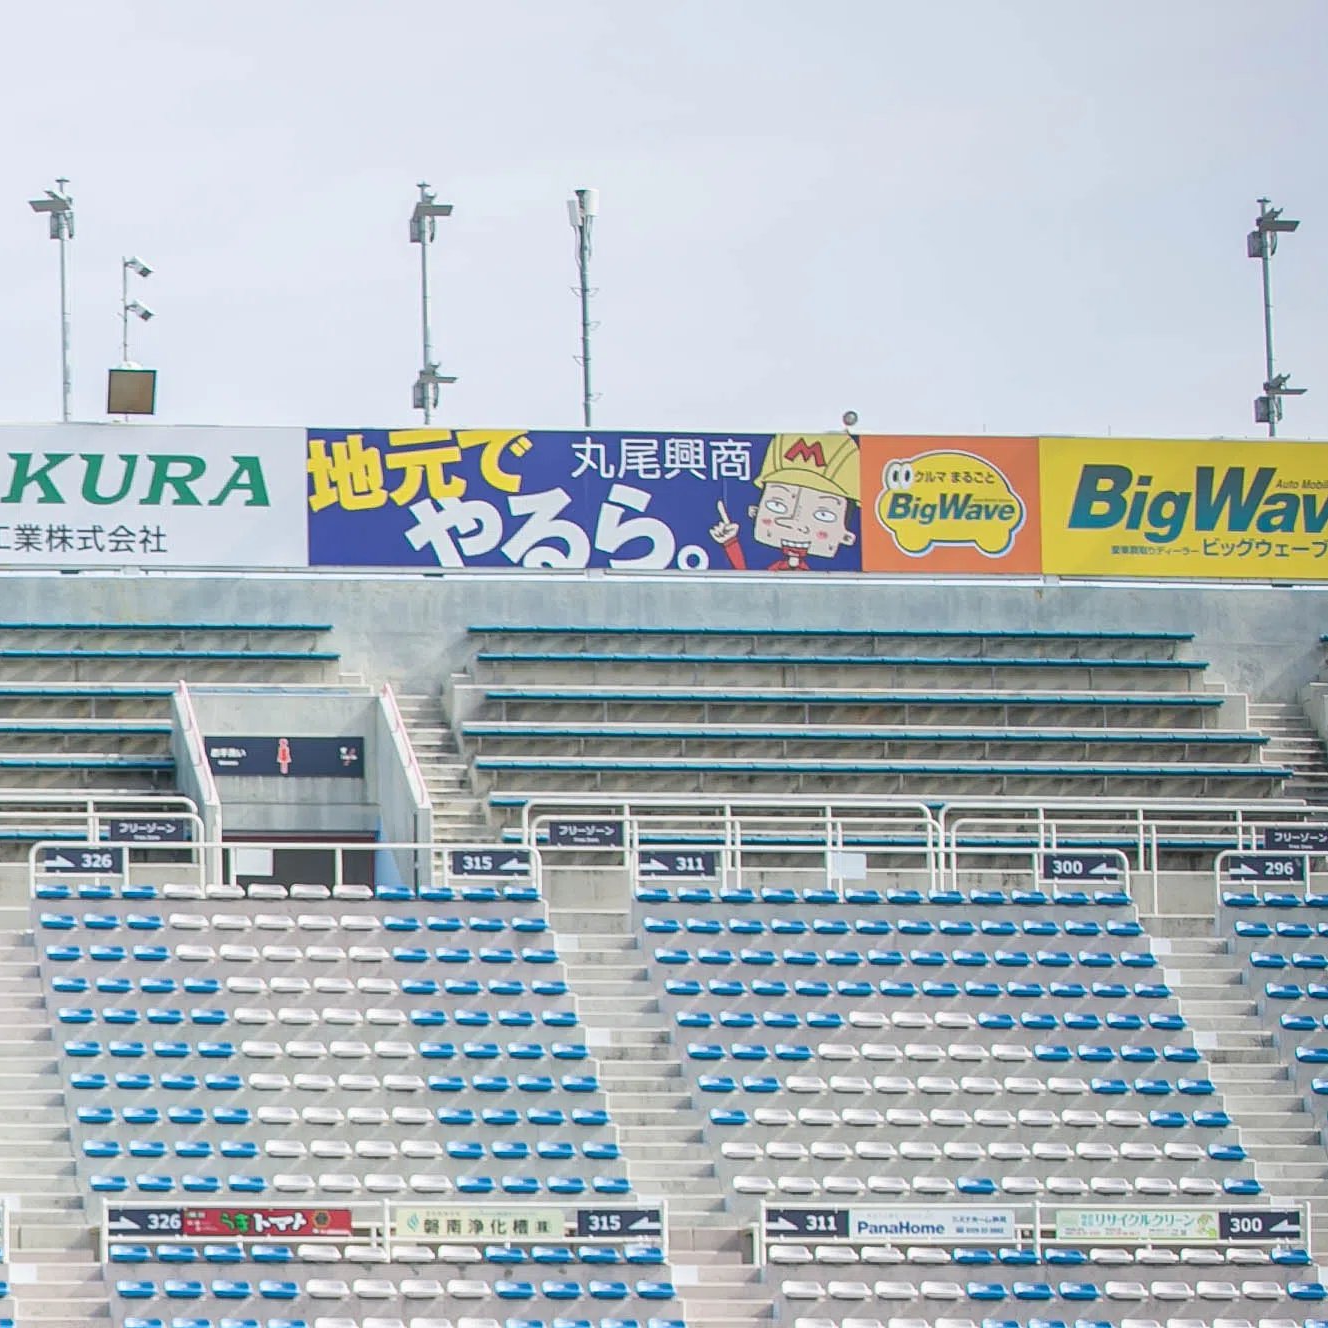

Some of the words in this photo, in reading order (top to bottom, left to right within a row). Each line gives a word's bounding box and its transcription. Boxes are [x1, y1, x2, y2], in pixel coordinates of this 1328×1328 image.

[572, 437, 752, 480] 丸尾興商
[306, 430, 535, 513] 地元で
[914, 471, 946, 483] クルマ
[950, 470, 996, 484] まるごと
[887, 492, 1016, 524] BigWave
[119, 823, 176, 833] フリーゾーン
[559, 826, 615, 835] フリーゾーン
[1275, 832, 1327, 842] フリーゾーン
[79, 854, 110, 868] 326
[462, 856, 492, 871] 315
[675, 857, 705, 871] 311
[1053, 860, 1083, 874] 300
[1265, 862, 1294, 876] 296
[148, 1214, 181, 1229] 326
[589, 1215, 621, 1230] 315
[806, 1215, 837, 1230] 311
[1093, 1211, 1196, 1228] リサイクルクリーン
[1231, 1218, 1262, 1232] 300
[858, 1221, 944, 1234] PanaHome
